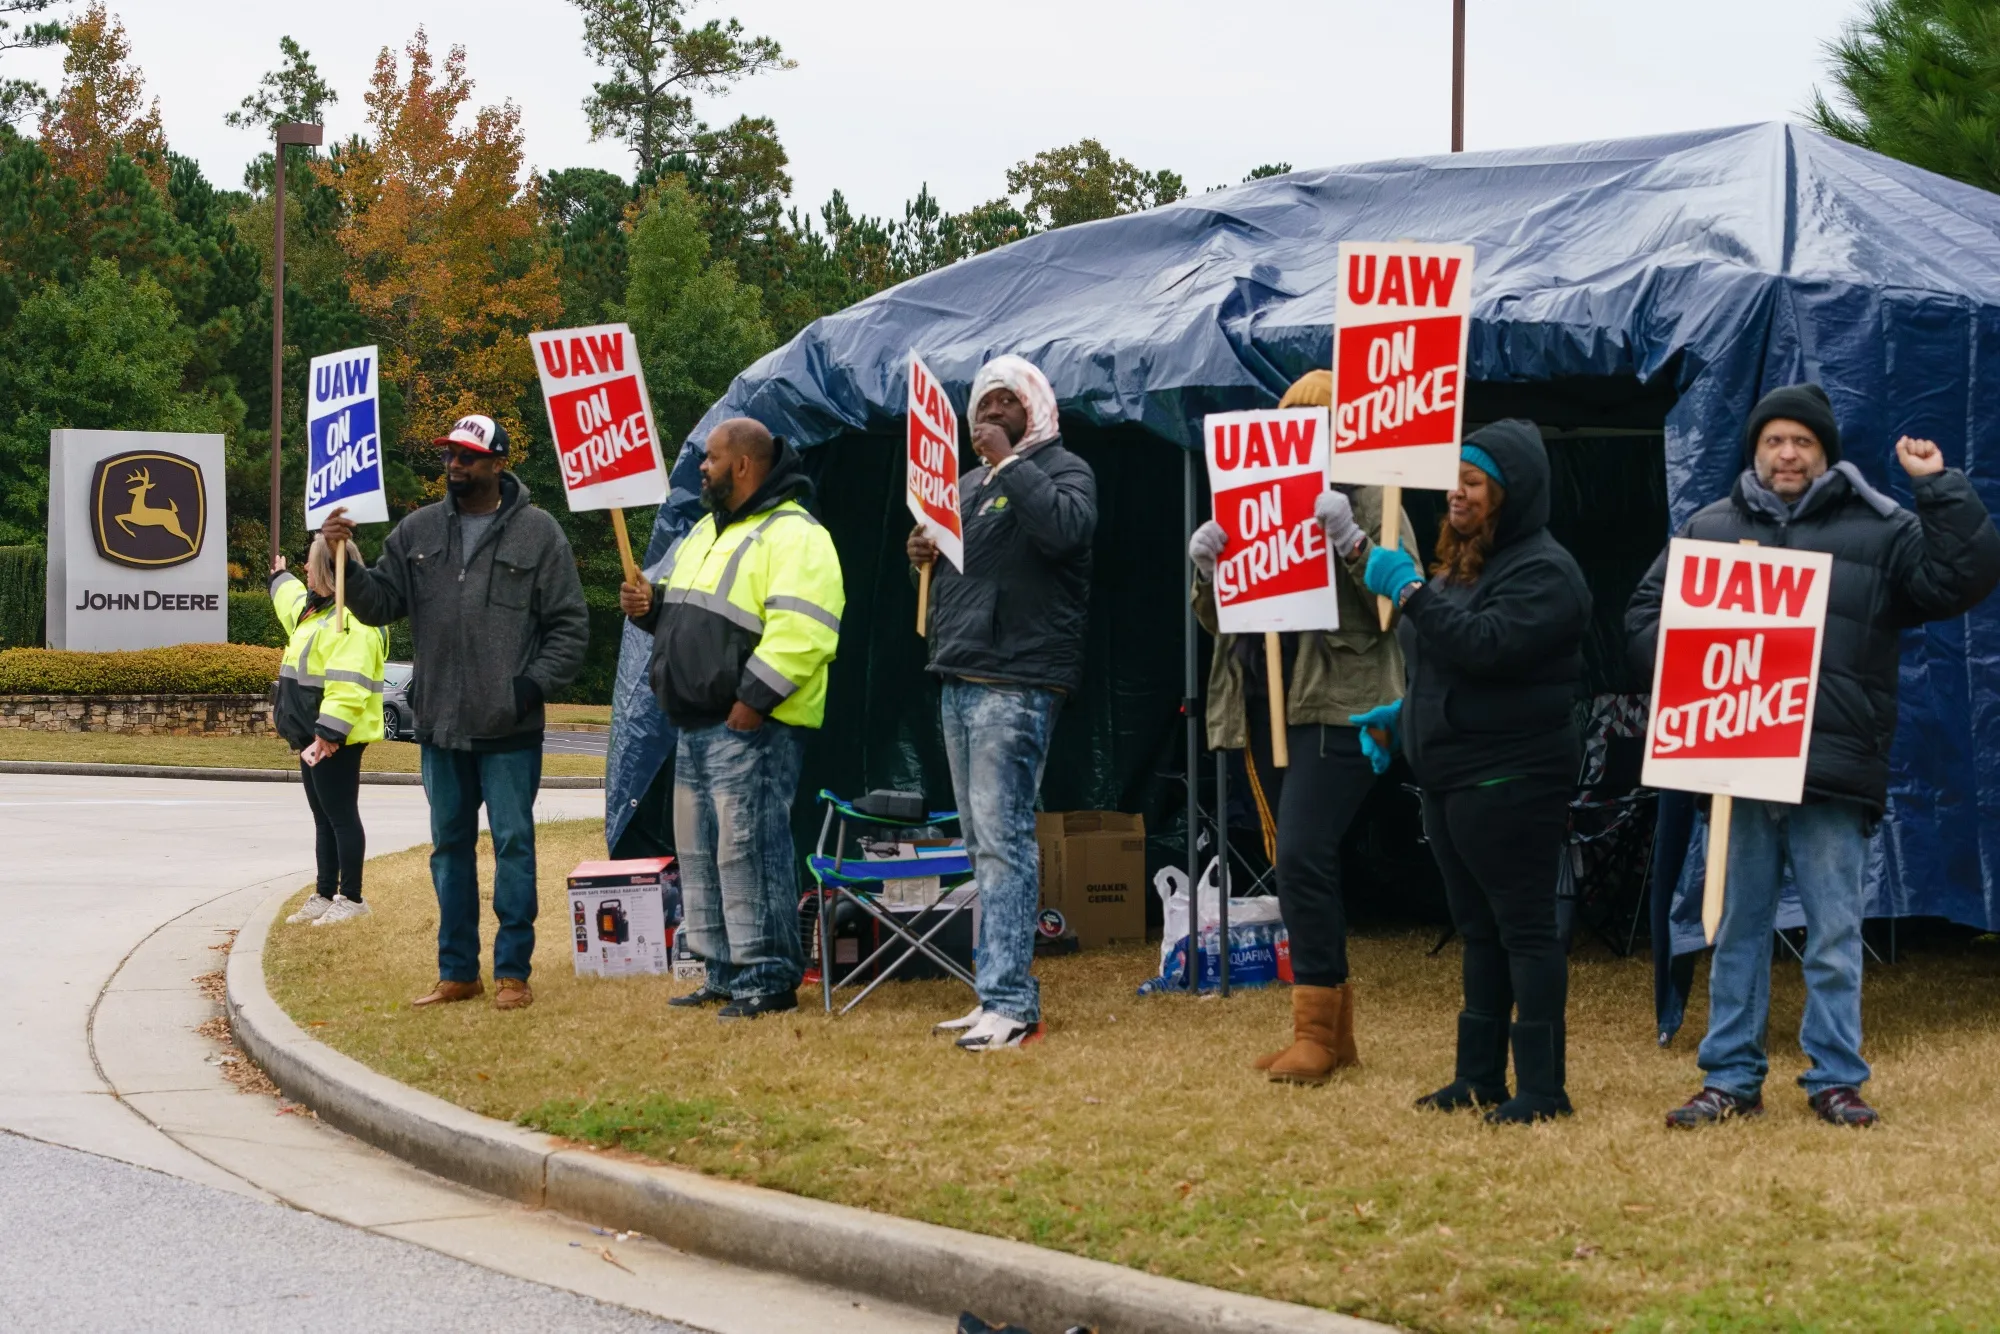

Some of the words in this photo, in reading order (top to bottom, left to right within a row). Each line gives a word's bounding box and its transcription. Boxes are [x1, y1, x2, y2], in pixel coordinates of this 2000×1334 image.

[1348, 255, 1461, 308] UAW
[316, 358, 371, 402] UAW
[540, 332, 624, 379] UAW
[1368, 325, 1416, 384] ON
[452, 419, 486, 443] LANTA
[575, 388, 612, 434] ON
[914, 361, 955, 450] UAW
[1336, 364, 1458, 449] STRIKE
[326, 409, 350, 457] ON
[562, 411, 649, 486] STRIKE
[919, 434, 946, 475] ON
[1214, 419, 1317, 471] UAW
[309, 433, 377, 507] STRIKE
[909, 460, 959, 516] STRIKE
[1239, 484, 1283, 541] ON
[1217, 517, 1326, 602] STRIKE
[76, 590, 139, 611] JOHN
[144, 590, 219, 611] DEERE
[1680, 555, 1816, 618] UAW
[1702, 633, 1765, 690] ON
[1654, 677, 1810, 754] STRIKE
[1086, 883, 1128, 893] QUAKER
[1088, 894, 1126, 904] CEREAL
[1228, 948, 1273, 966] QUAFINA
